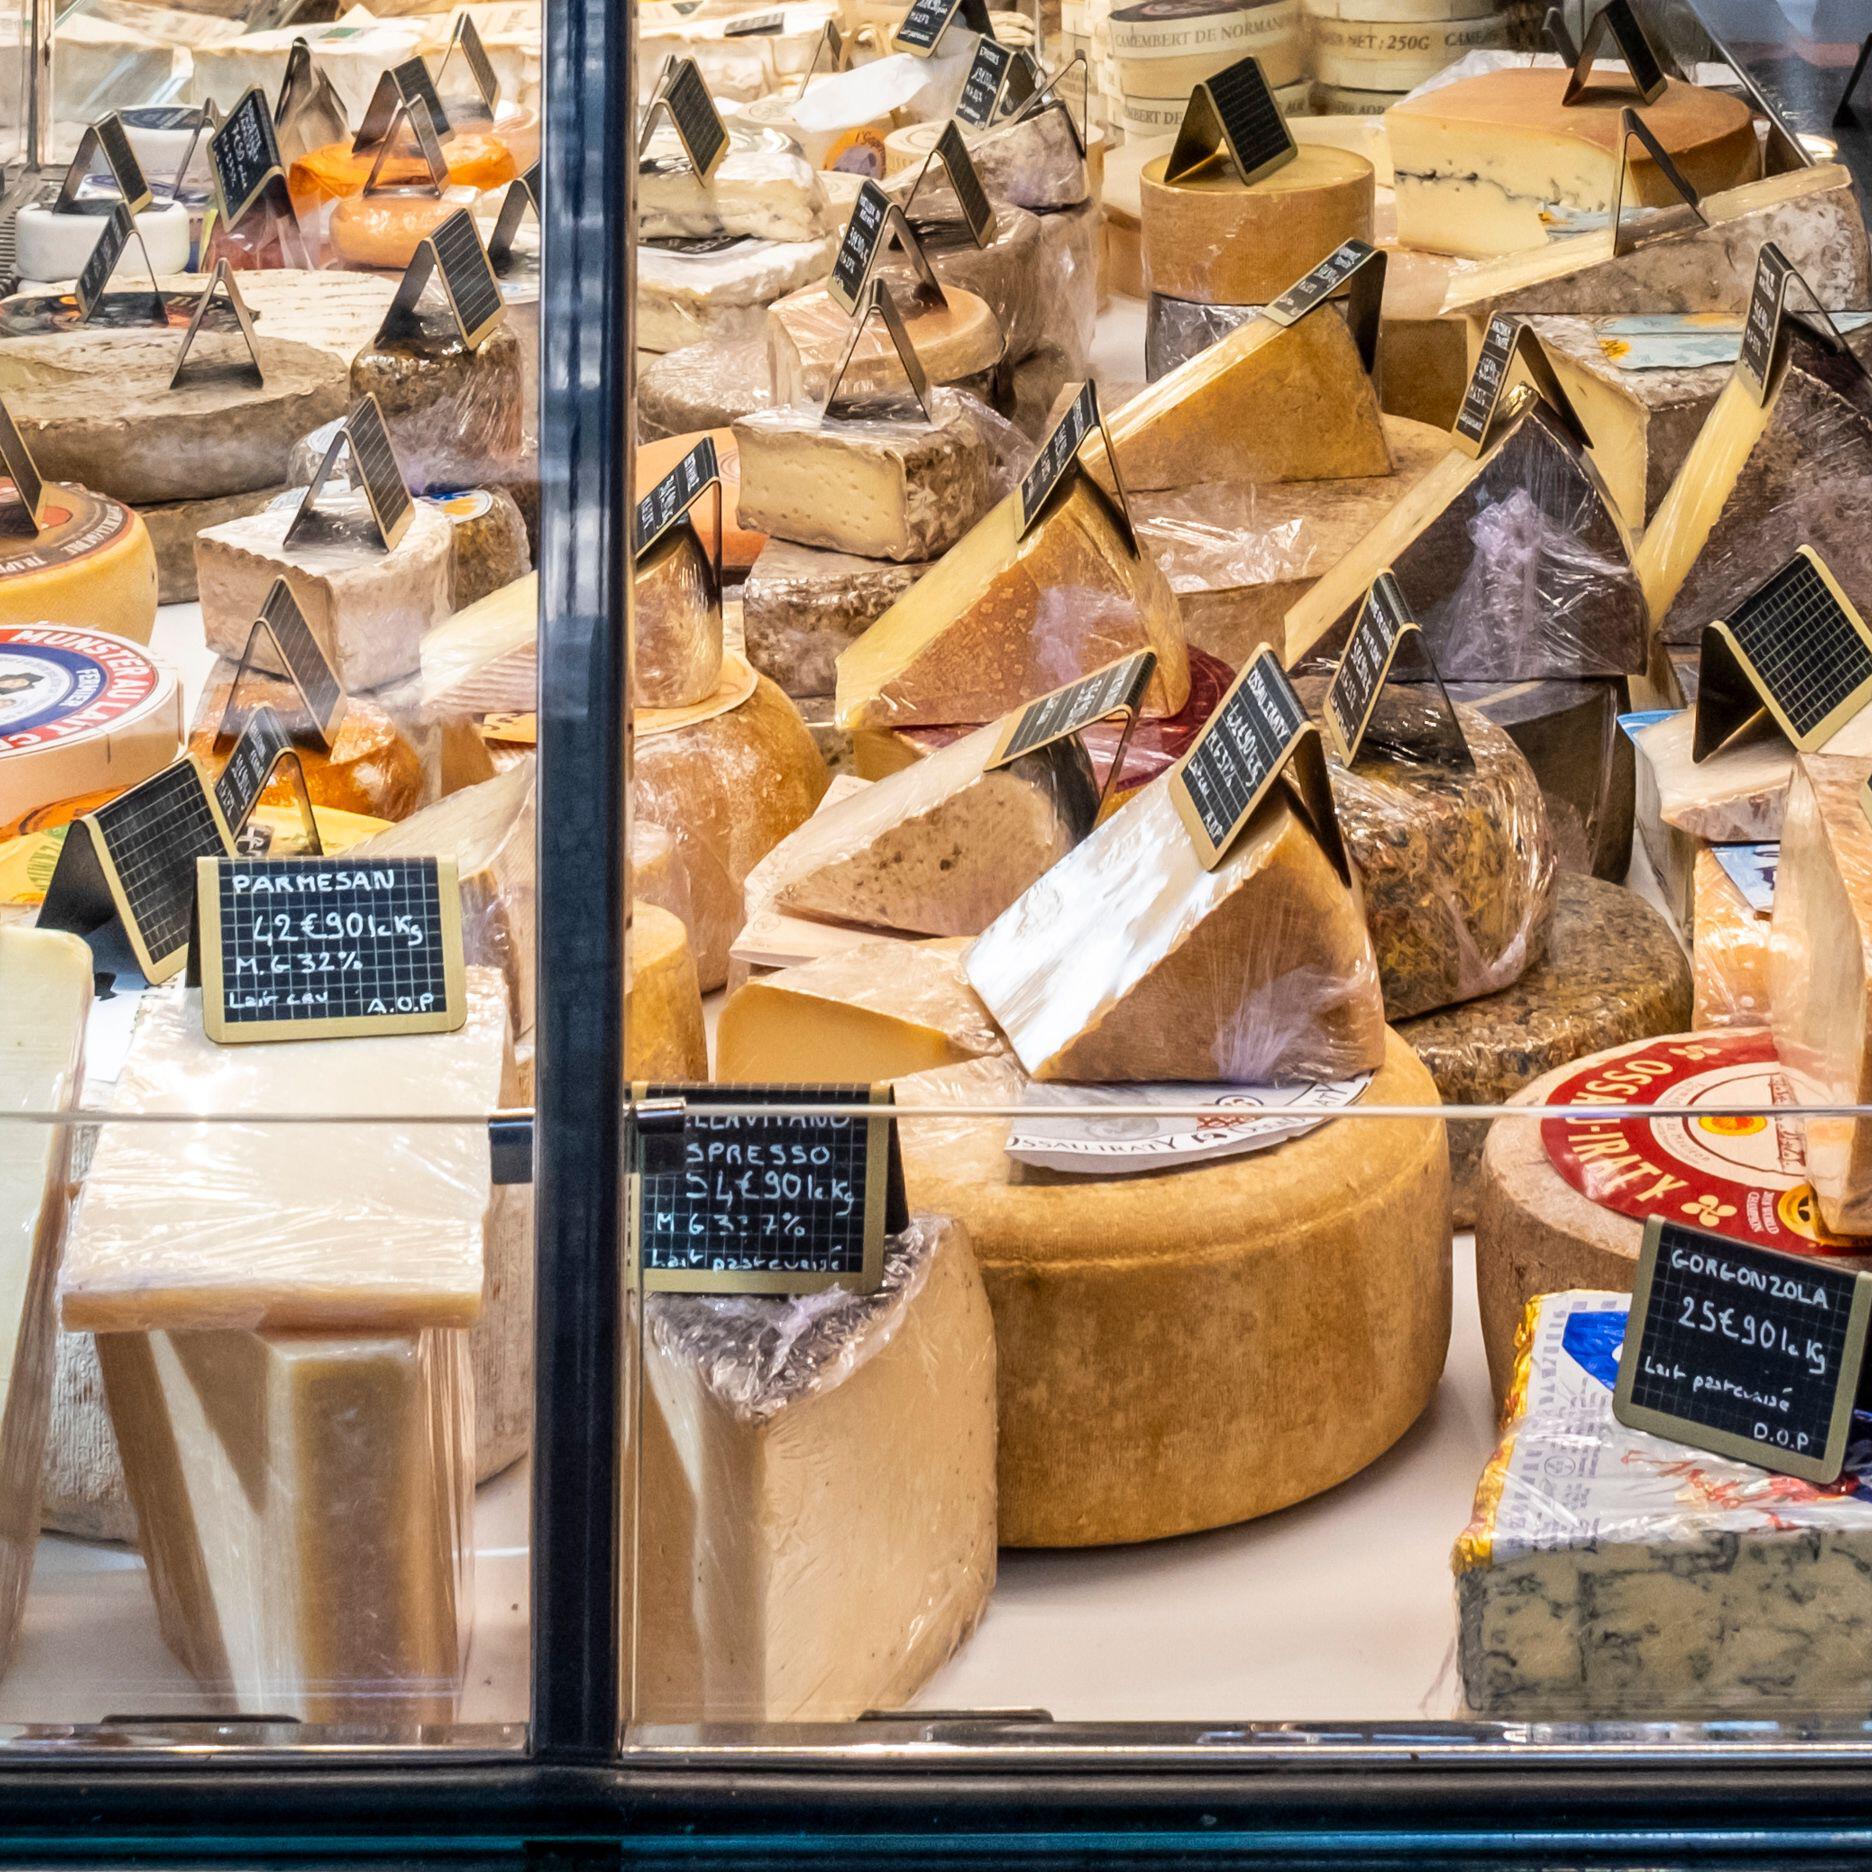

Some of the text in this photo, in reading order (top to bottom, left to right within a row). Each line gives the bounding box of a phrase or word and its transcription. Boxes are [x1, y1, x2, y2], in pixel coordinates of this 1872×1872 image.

[1115, 18, 1285, 48] CAMEMBERT DE NORMAN
[1386, 35, 1430, 51] 250G
[10, 629, 150, 675] MUNSTER
[107, 678, 150, 701] AU
[232, 869, 395, 894] PARMESAN
[253, 912, 423, 946] 42€90 Kg
[300, 951, 363, 973] 32%
[367, 993, 434, 1013] A.O.P
[686, 1143, 830, 1165] SPRESSO
[685, 1171, 854, 1216] 54€90 Kg
[1671, 1249, 1829, 1309] GORGONZOLA
[1679, 1296, 1826, 1374] 25€90 Kg
[1753, 1422, 1809, 1452] D.O.P
